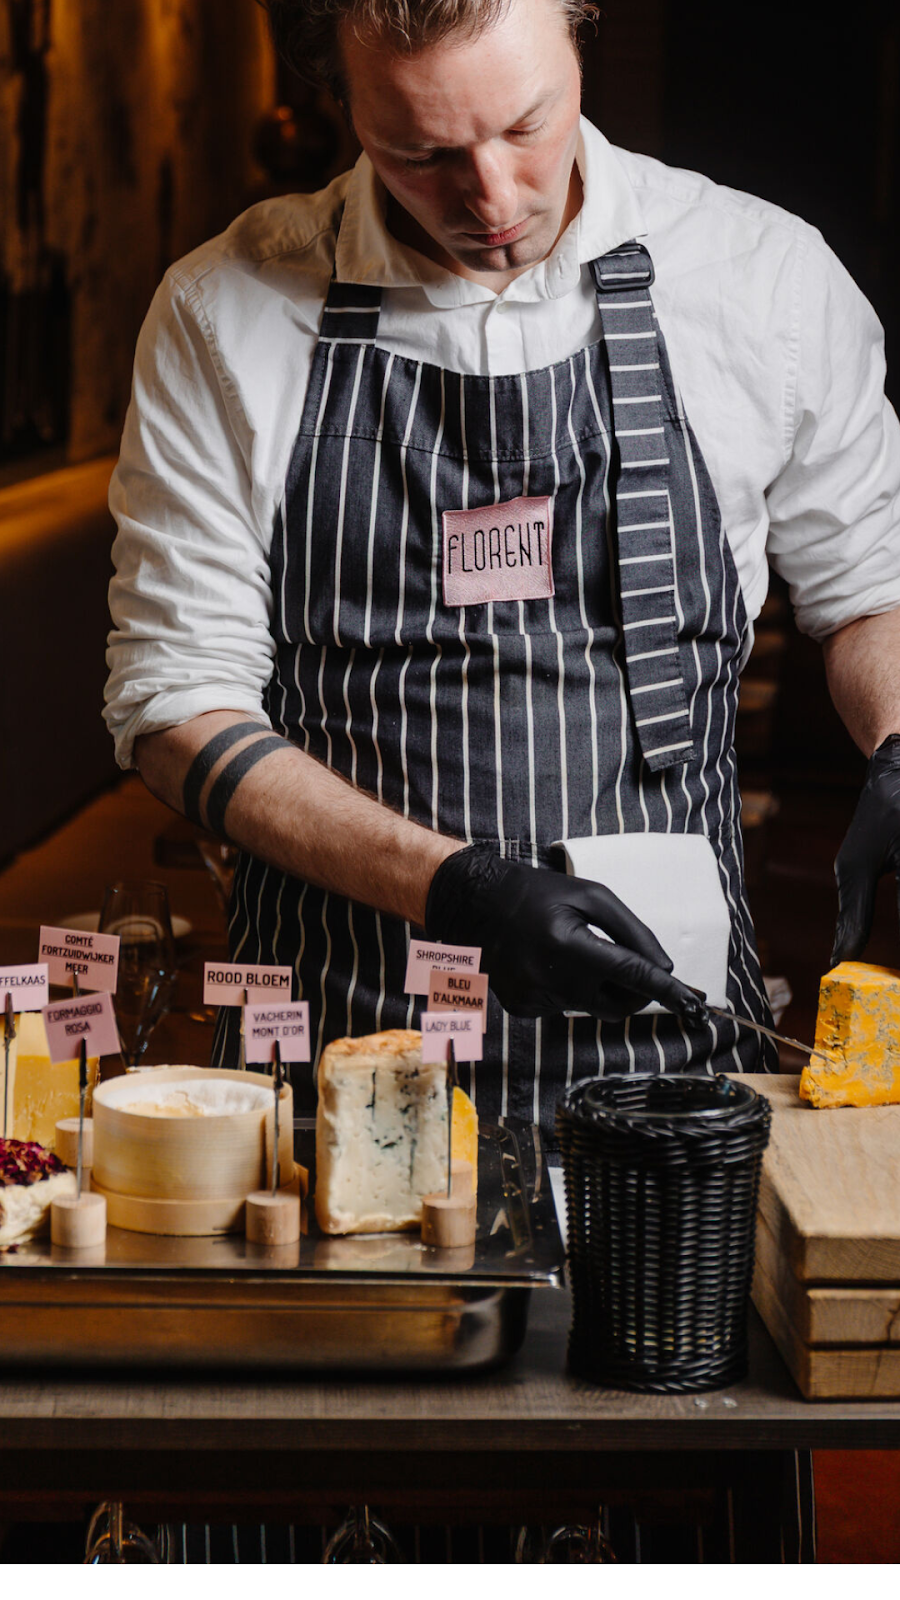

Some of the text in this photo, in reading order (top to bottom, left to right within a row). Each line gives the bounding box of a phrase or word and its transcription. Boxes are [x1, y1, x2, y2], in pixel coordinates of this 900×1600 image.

[448, 521, 545, 574] FLORENT
[65, 934, 93, 947] COMTÉ
[41, 944, 115, 963] FORTZUIDWIJKER
[416, 949, 474, 965] SHROPSHIRE
[65, 961, 88, 974] MEER
[207, 970, 290, 987] ROOD BLOEM
[448, 977, 471, 991] BLEU
[433, 992, 484, 1008] D'ALKMAAR
[47, 1002, 103, 1022] FORMAGGIO
[253, 1010, 303, 1022] VACHERIN
[64, 1021, 91, 1036] ROSA
[252, 1025, 305, 1038] MONT D'OR
[425, 1020, 472, 1032] LADY BLUE
